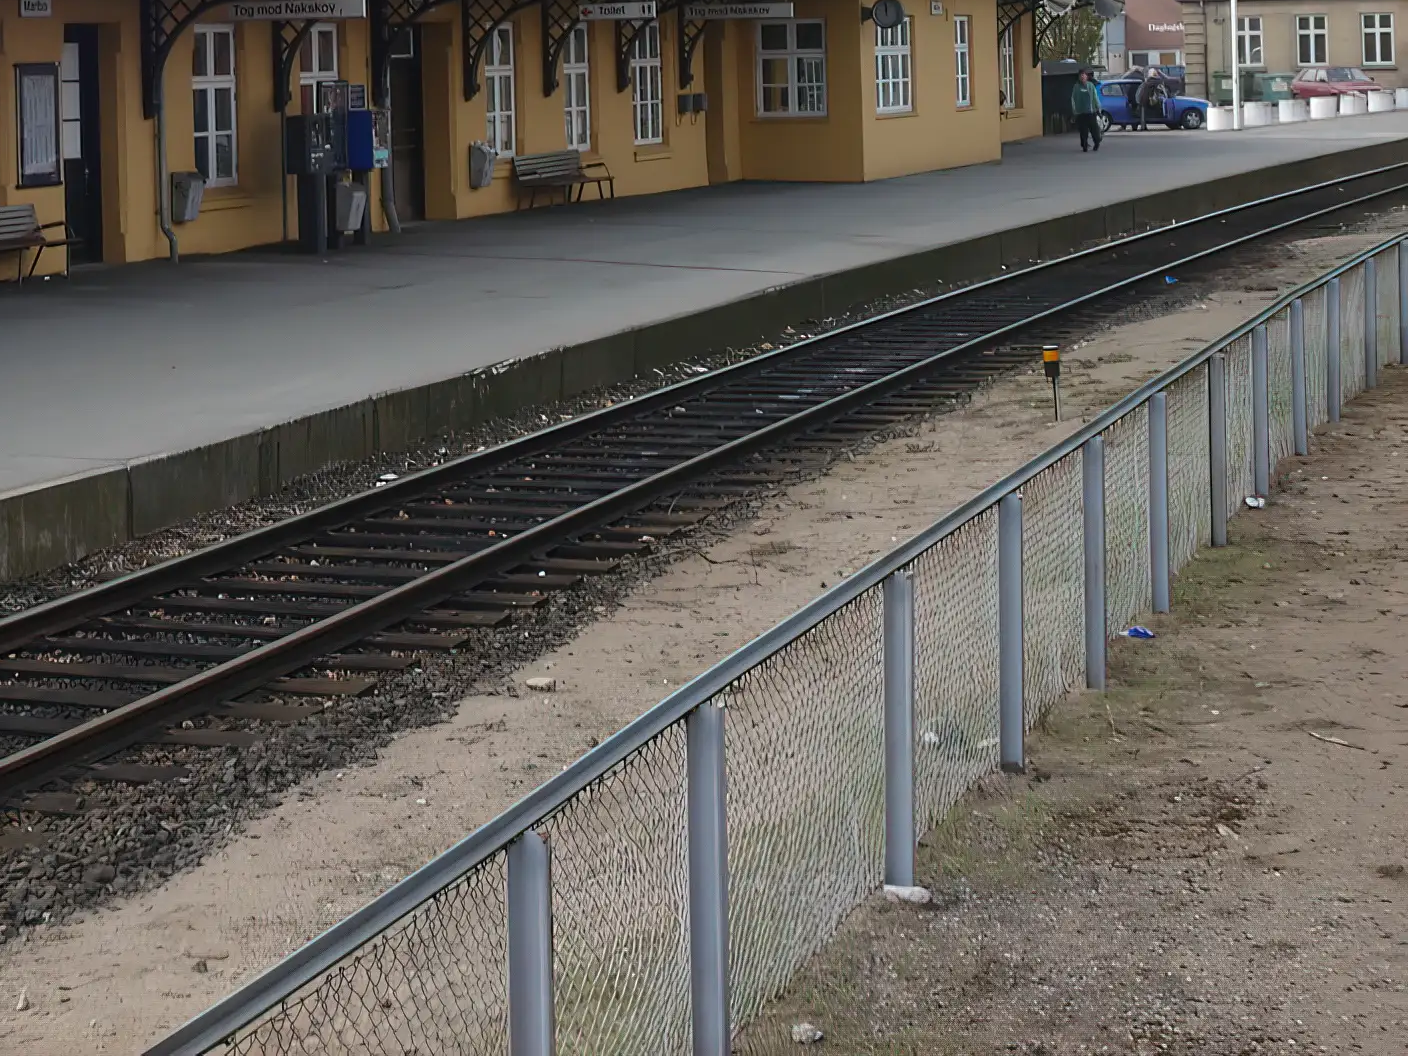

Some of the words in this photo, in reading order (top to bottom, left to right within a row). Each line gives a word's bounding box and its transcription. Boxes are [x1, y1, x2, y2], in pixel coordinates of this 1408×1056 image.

[233, 5, 254, 17] Tog
[258, 4, 282, 15] mod
[285, 2, 335, 14] Nakskov
